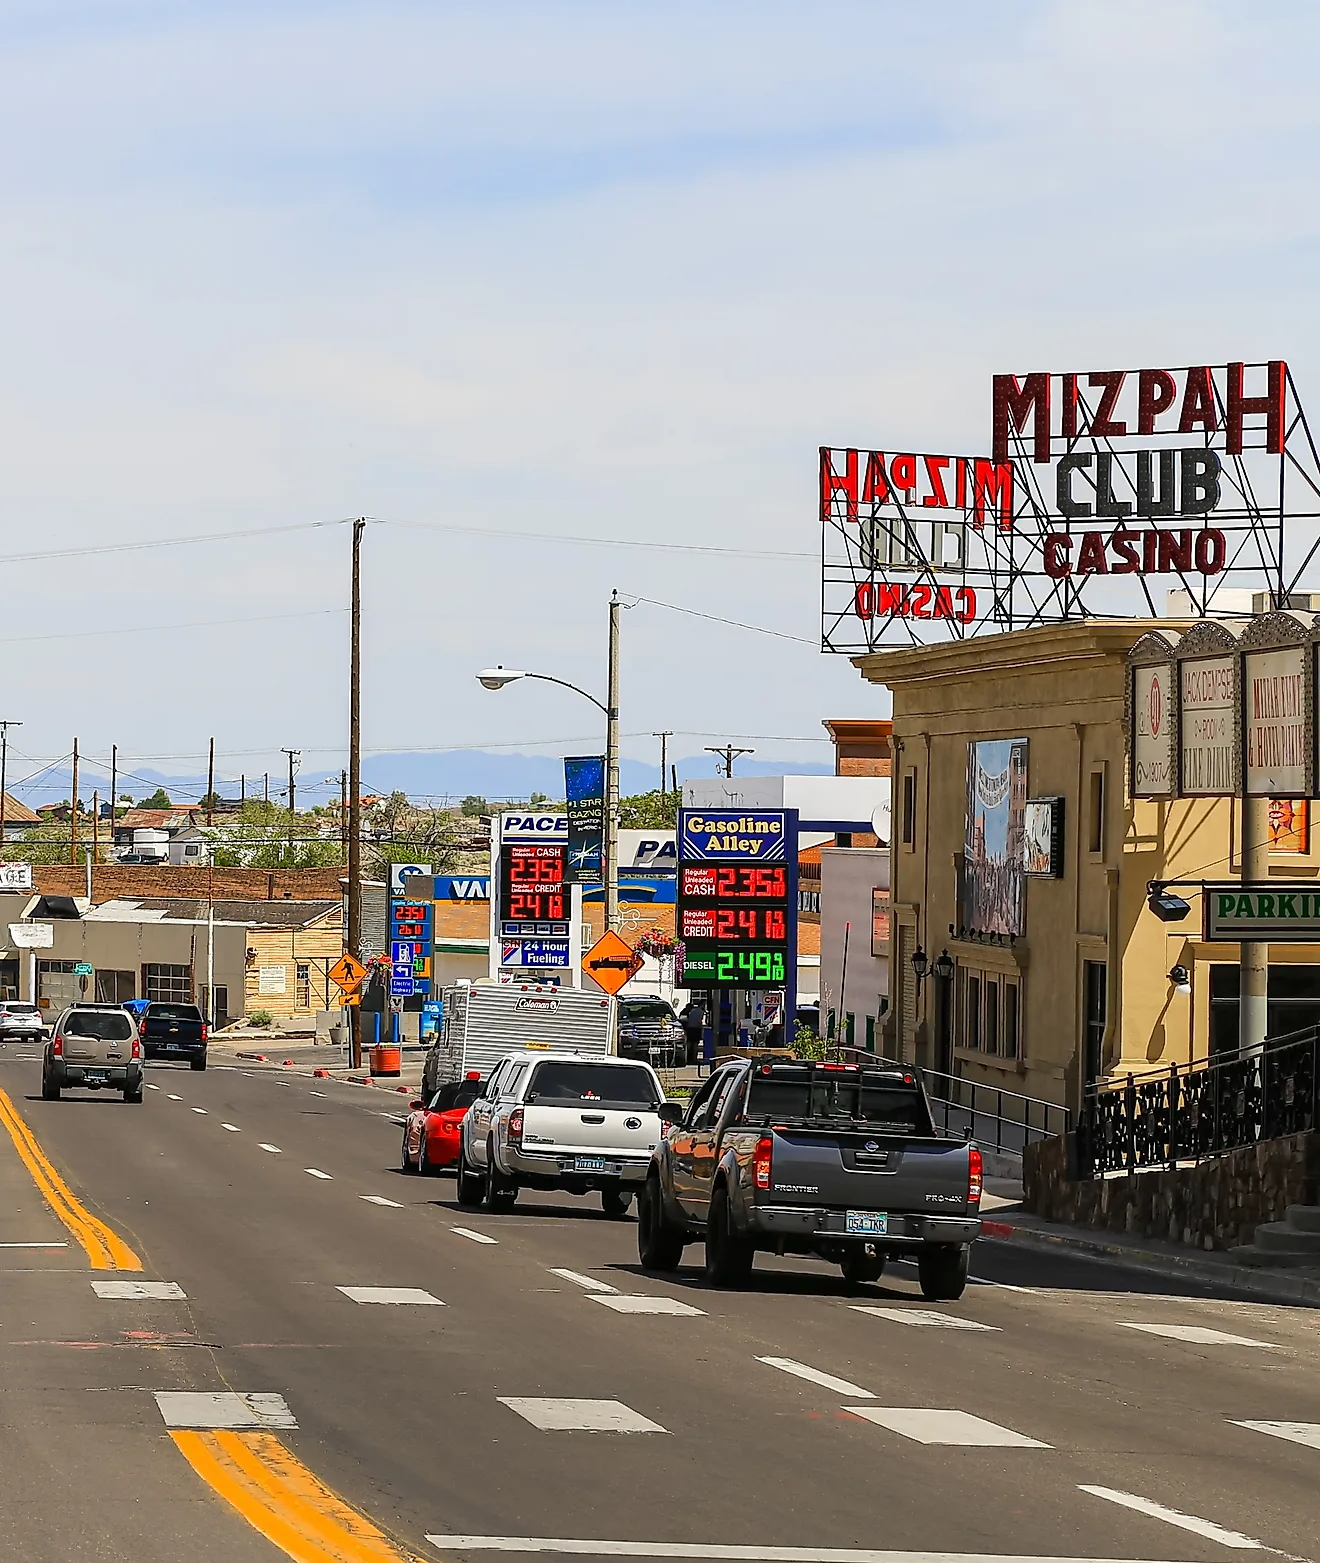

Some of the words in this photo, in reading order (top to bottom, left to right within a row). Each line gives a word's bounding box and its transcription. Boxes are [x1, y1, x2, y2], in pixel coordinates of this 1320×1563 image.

[992, 361, 1286, 463] MIZPAH
[1056, 448, 1221, 518] CLUB
[1043, 528, 1227, 579] CASINO
[580, 798, 601, 808] STAR
[504, 817, 568, 831] PACE
[688, 816, 781, 833] Gasoline
[705, 835, 763, 855] Alley
[536, 848, 561, 857] CASH
[684, 868, 708, 877] Regular
[534, 884, 561, 893] CREDIT
[684, 884, 716, 895] CASH
[684, 910, 707, 918] Regular
[683, 926, 714, 937] CREDIT
[524, 941, 539, 951] 24
[542, 941, 568, 951] Hour
[527, 953, 565, 965] Fueling
[683, 961, 714, 970] DIESEL
[774, 1184, 819, 1194] FRONTIER
